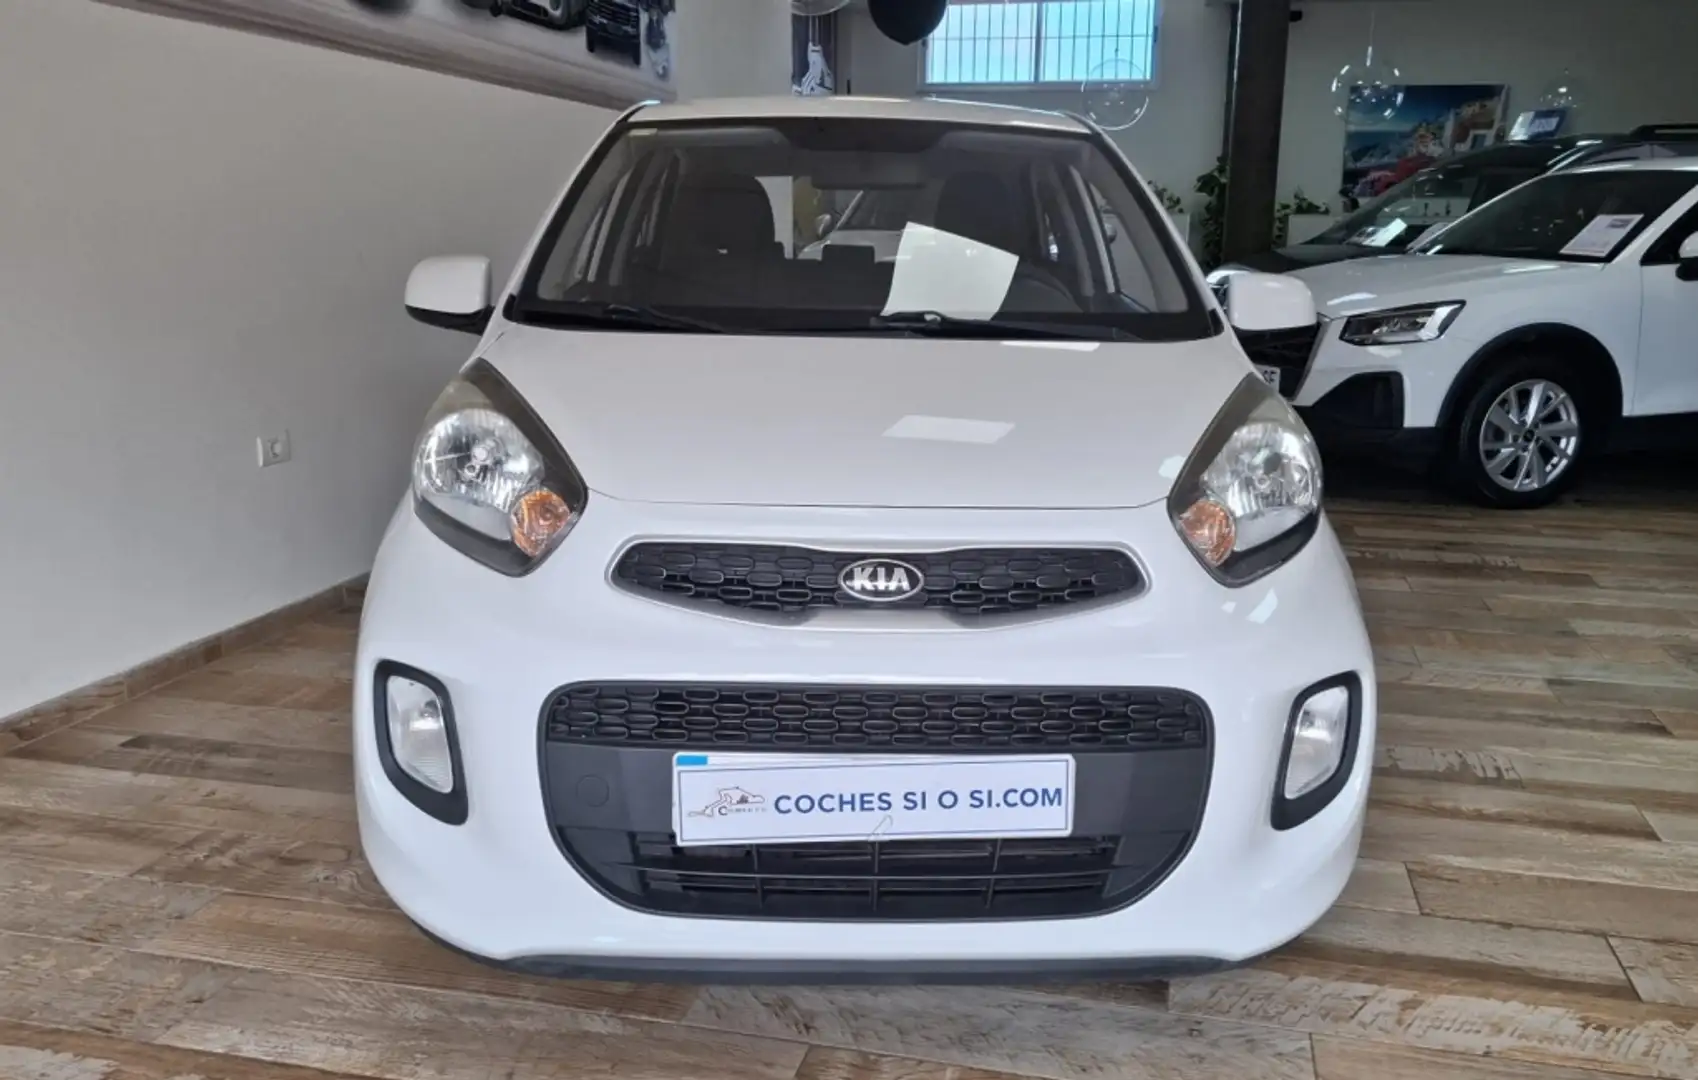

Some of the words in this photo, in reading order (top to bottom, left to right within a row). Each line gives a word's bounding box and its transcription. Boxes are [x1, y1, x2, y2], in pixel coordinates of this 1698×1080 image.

[852, 566, 911, 591] KIA
[774, 792, 892, 814] COCHES
[903, 791, 927, 811] SI
[938, 789, 958, 809] O
[969, 788, 1062, 808] SI.COM
